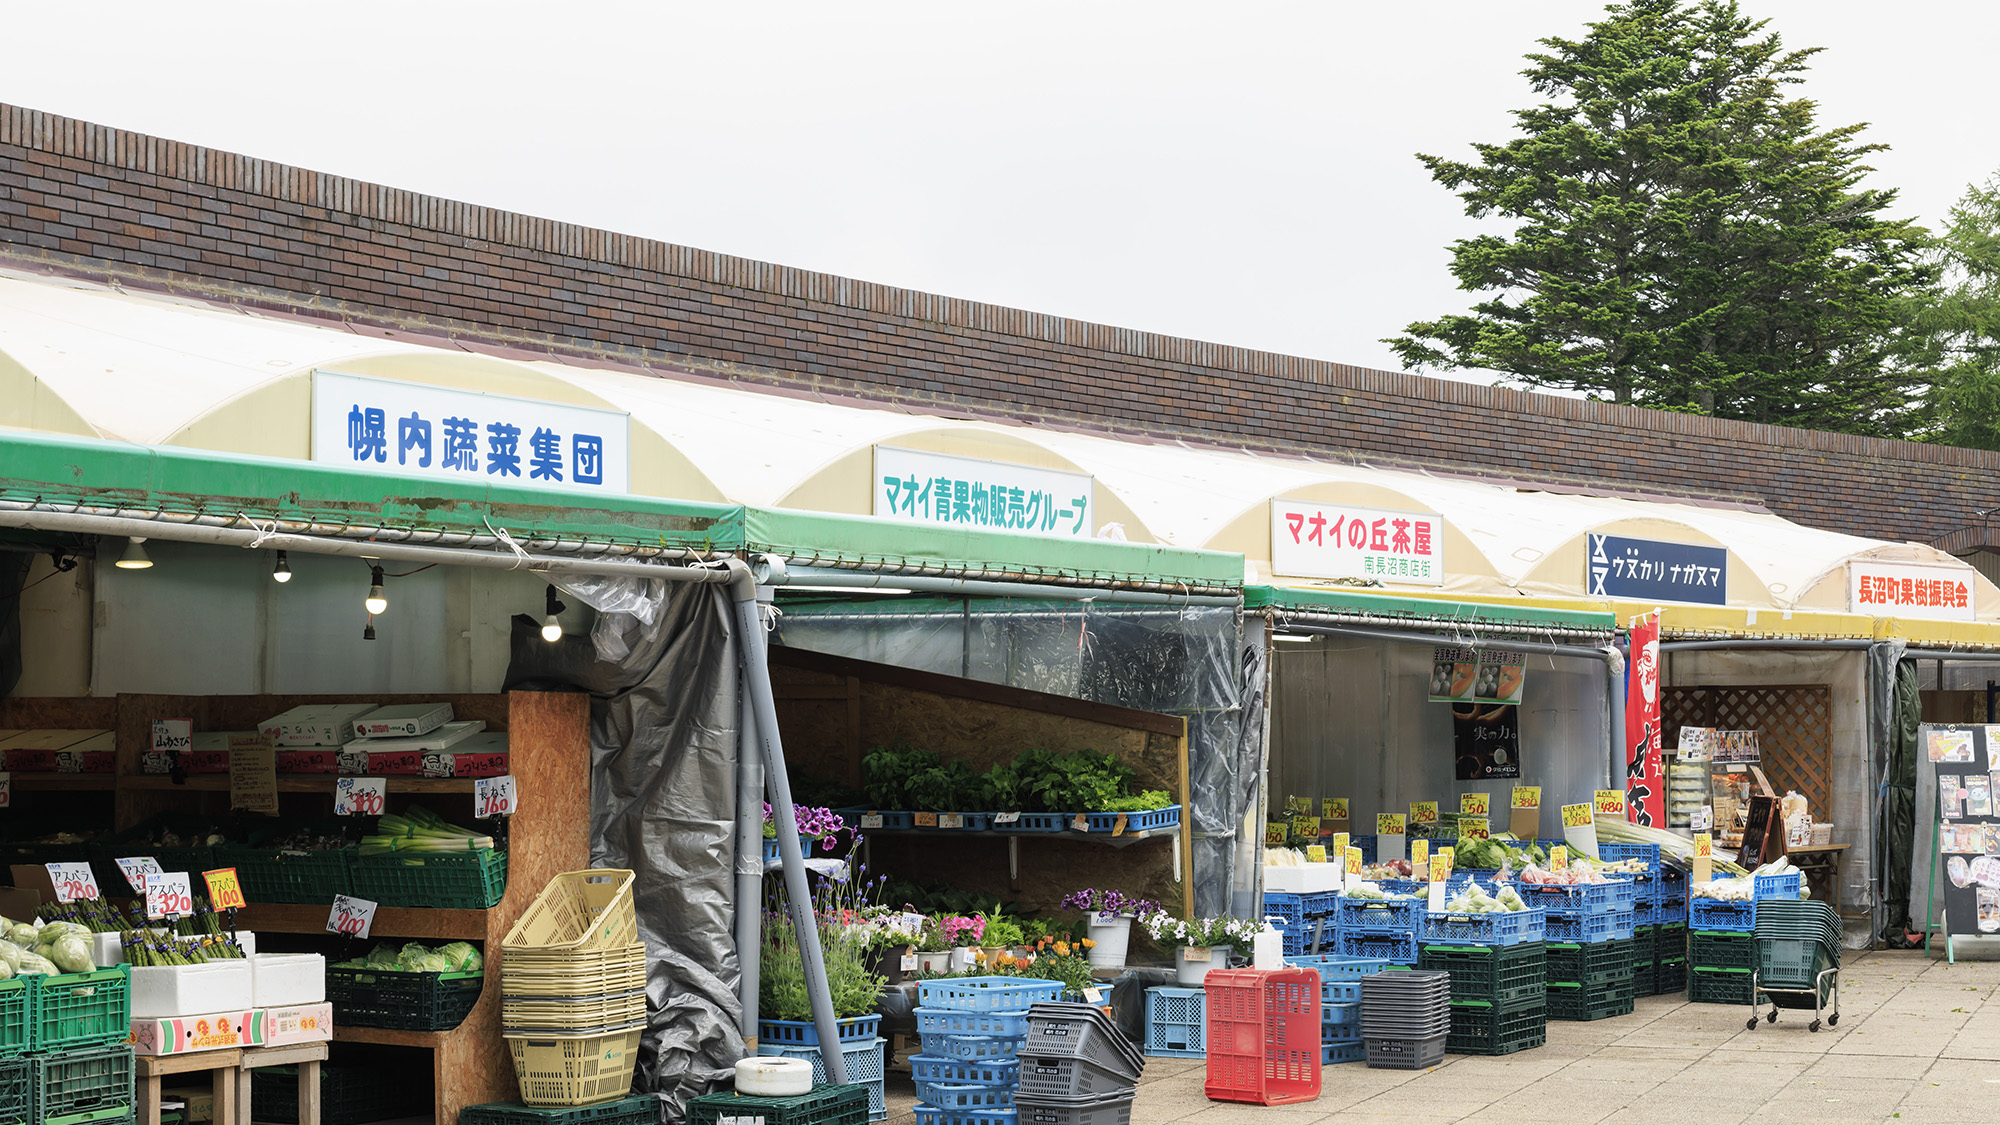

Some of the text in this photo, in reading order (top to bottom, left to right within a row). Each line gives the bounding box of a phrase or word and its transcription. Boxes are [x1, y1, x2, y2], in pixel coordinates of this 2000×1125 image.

[348, 404, 603, 486] 幌内蔬菜集団
[884, 474, 1087, 535] マオイ青果物販売グループ
[1286, 511, 1432, 555] マオイの丘茶屋
[1364, 556, 1431, 578] 南長沼商店街
[1859, 575, 1968, 608] 長沼町果樹振興会
[156, 735, 190, 749] 山わさび
[484, 796, 508, 814] 160
[1330, 808, 1347, 818] 150
[1601, 801, 1623, 813] 480
[1416, 810, 1436, 822] 250
[1571, 815, 1591, 827] 200
[1299, 826, 1319, 837] 150
[1384, 825, 1404, 834] 200
[53, 870, 89, 882] アスパラ
[124, 863, 158, 876] アスパラ
[64, 881, 97, 900] 280
[149, 882, 186, 896] アスパラ
[209, 877, 236, 893] アスパラ
[159, 893, 191, 914] 320
[219, 889, 240, 907] 100
[338, 912, 365, 935] 200
[196, 1016, 230, 1036] もも
